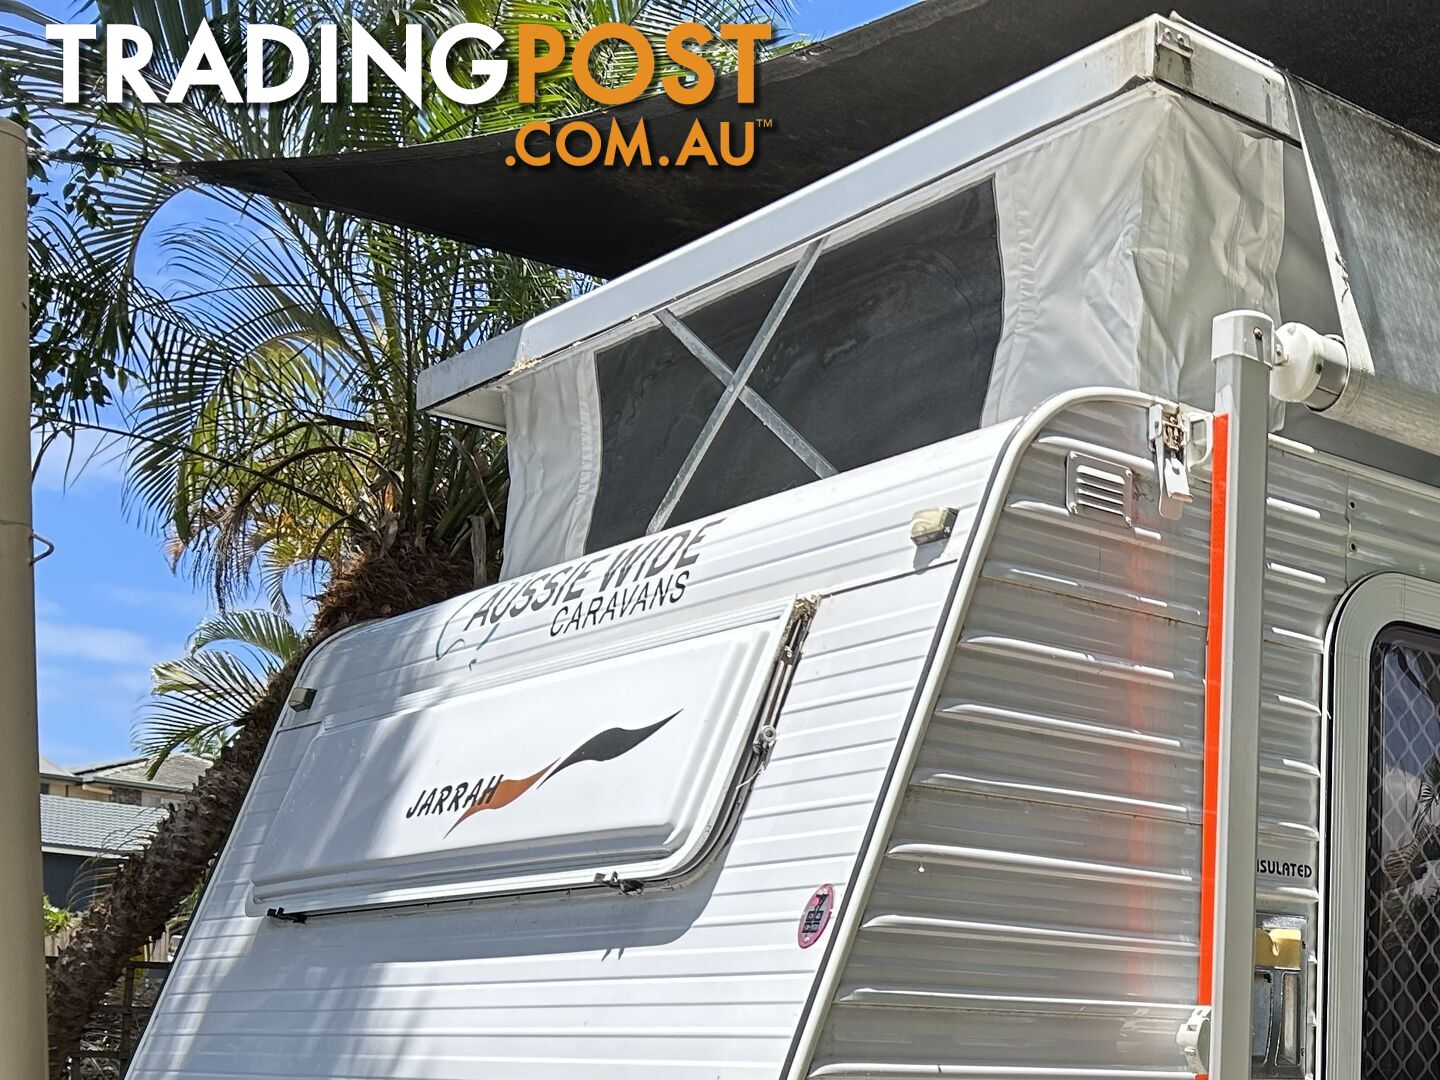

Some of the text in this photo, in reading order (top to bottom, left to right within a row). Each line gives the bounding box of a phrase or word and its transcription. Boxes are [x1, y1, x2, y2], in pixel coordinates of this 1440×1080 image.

[463, 517, 727, 631] AUSSIE WIDE
[550, 570, 690, 637] CARAVANS
[406, 774, 504, 818] JARRAH
